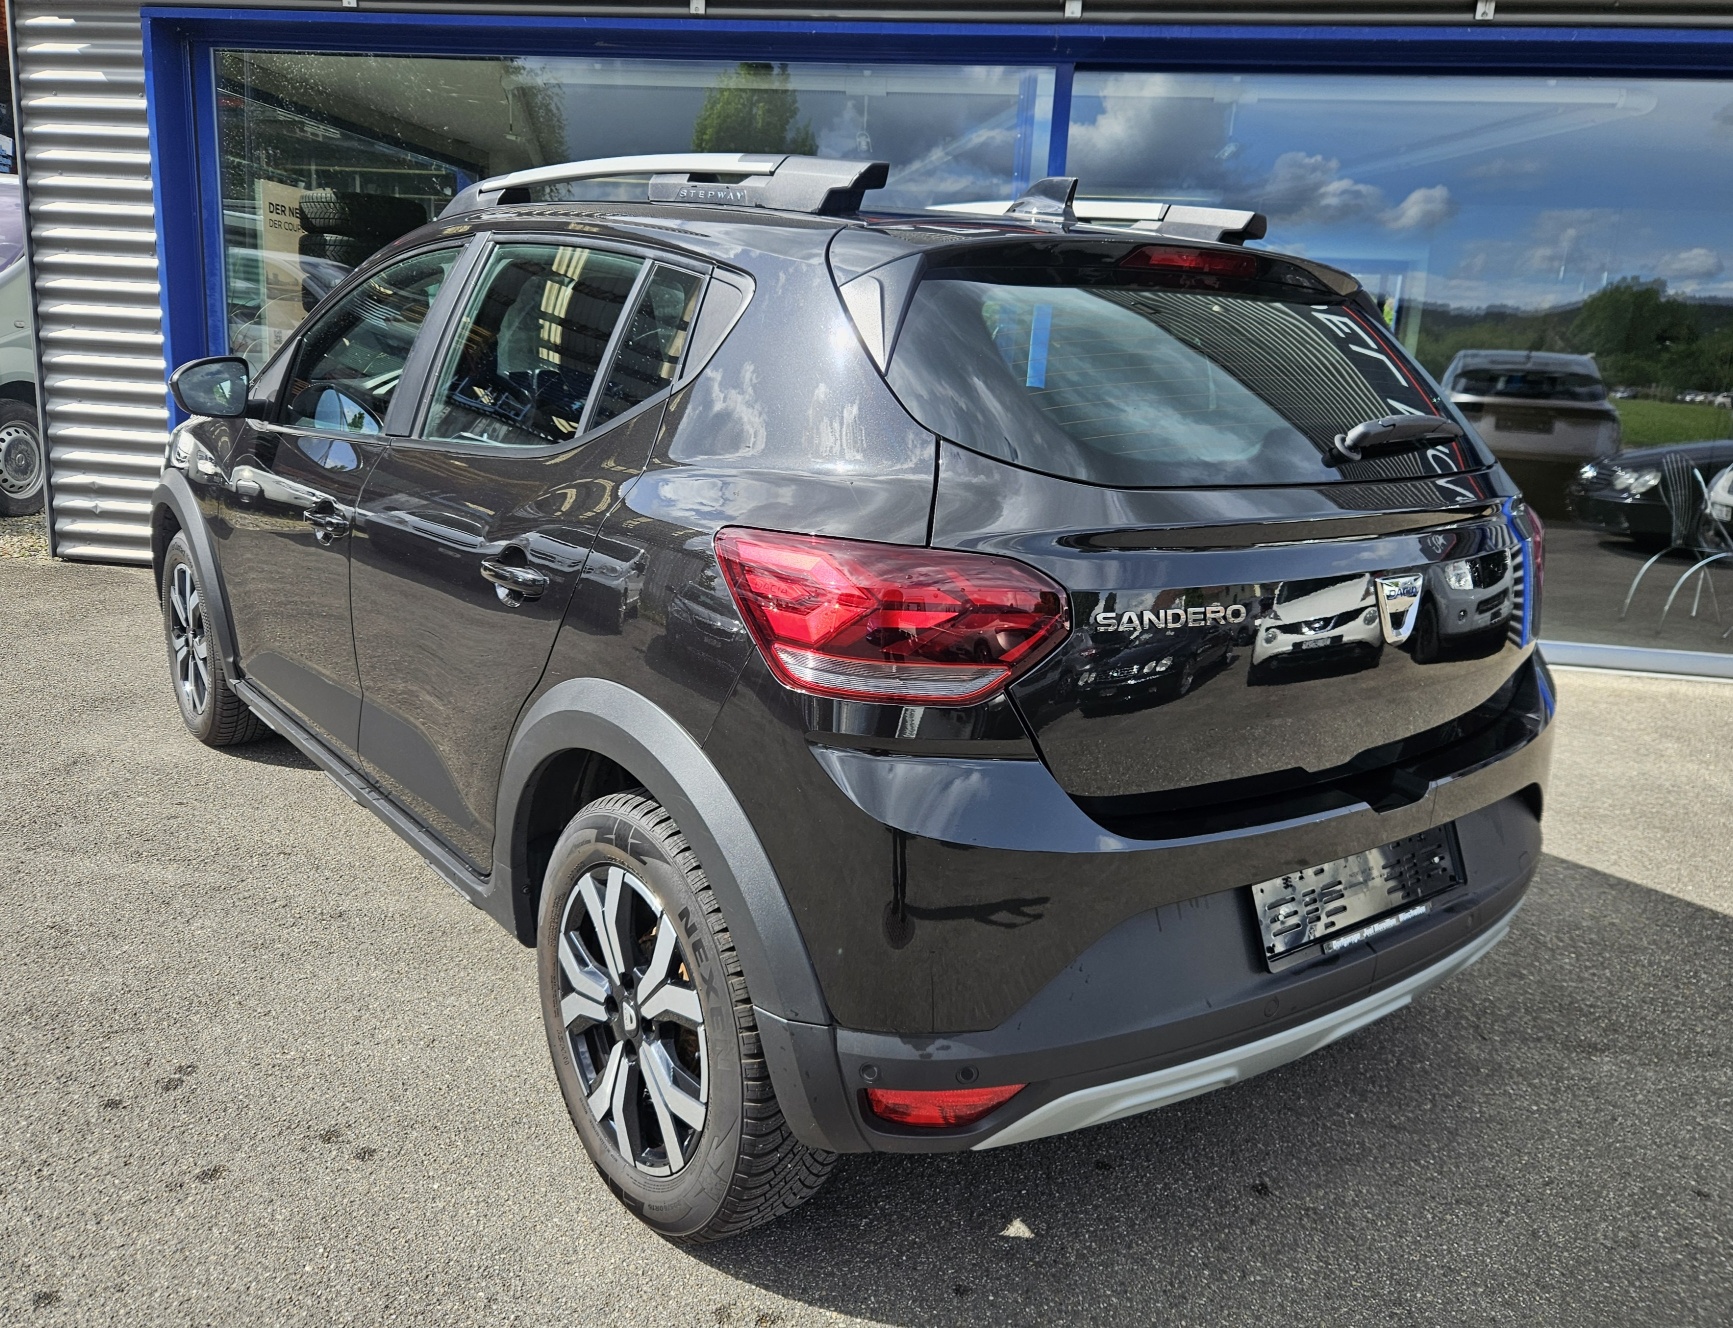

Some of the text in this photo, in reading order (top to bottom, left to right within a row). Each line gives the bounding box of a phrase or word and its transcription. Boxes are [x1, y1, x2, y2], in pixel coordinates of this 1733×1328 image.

[679, 188, 744, 202] STEPWAY
[268, 202, 287, 217] DER
[268, 218, 283, 230] DER
[755, 581, 788, 594] DACIA
[1386, 586, 1419, 601] DACIA
[1095, 604, 1247, 633] SANDERO
[677, 905, 728, 1071] NEXEN
